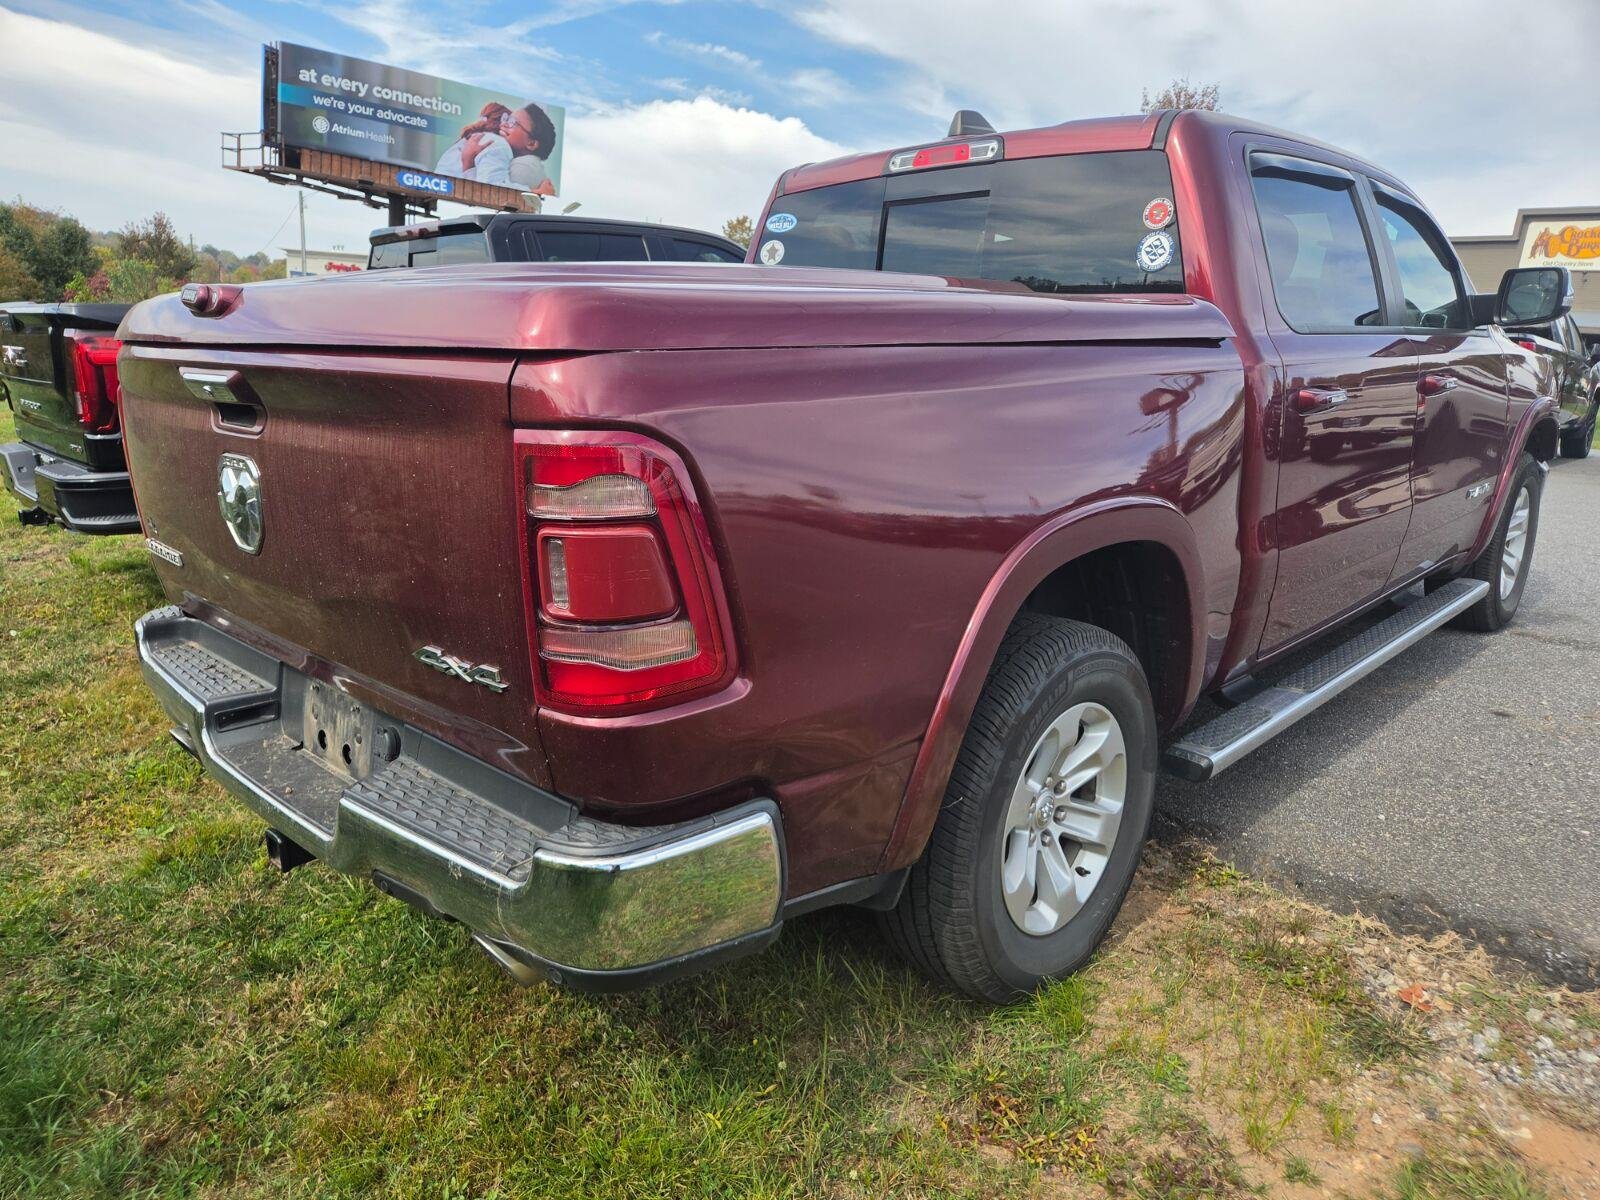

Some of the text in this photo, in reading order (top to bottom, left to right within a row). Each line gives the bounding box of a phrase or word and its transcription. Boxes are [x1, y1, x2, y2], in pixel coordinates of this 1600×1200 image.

[299, 67, 462, 116] at every connection
[313, 95, 428, 128] we're your advocate
[331, 123, 396, 145] Atrium Health
[402, 173, 449, 192] GRACE
